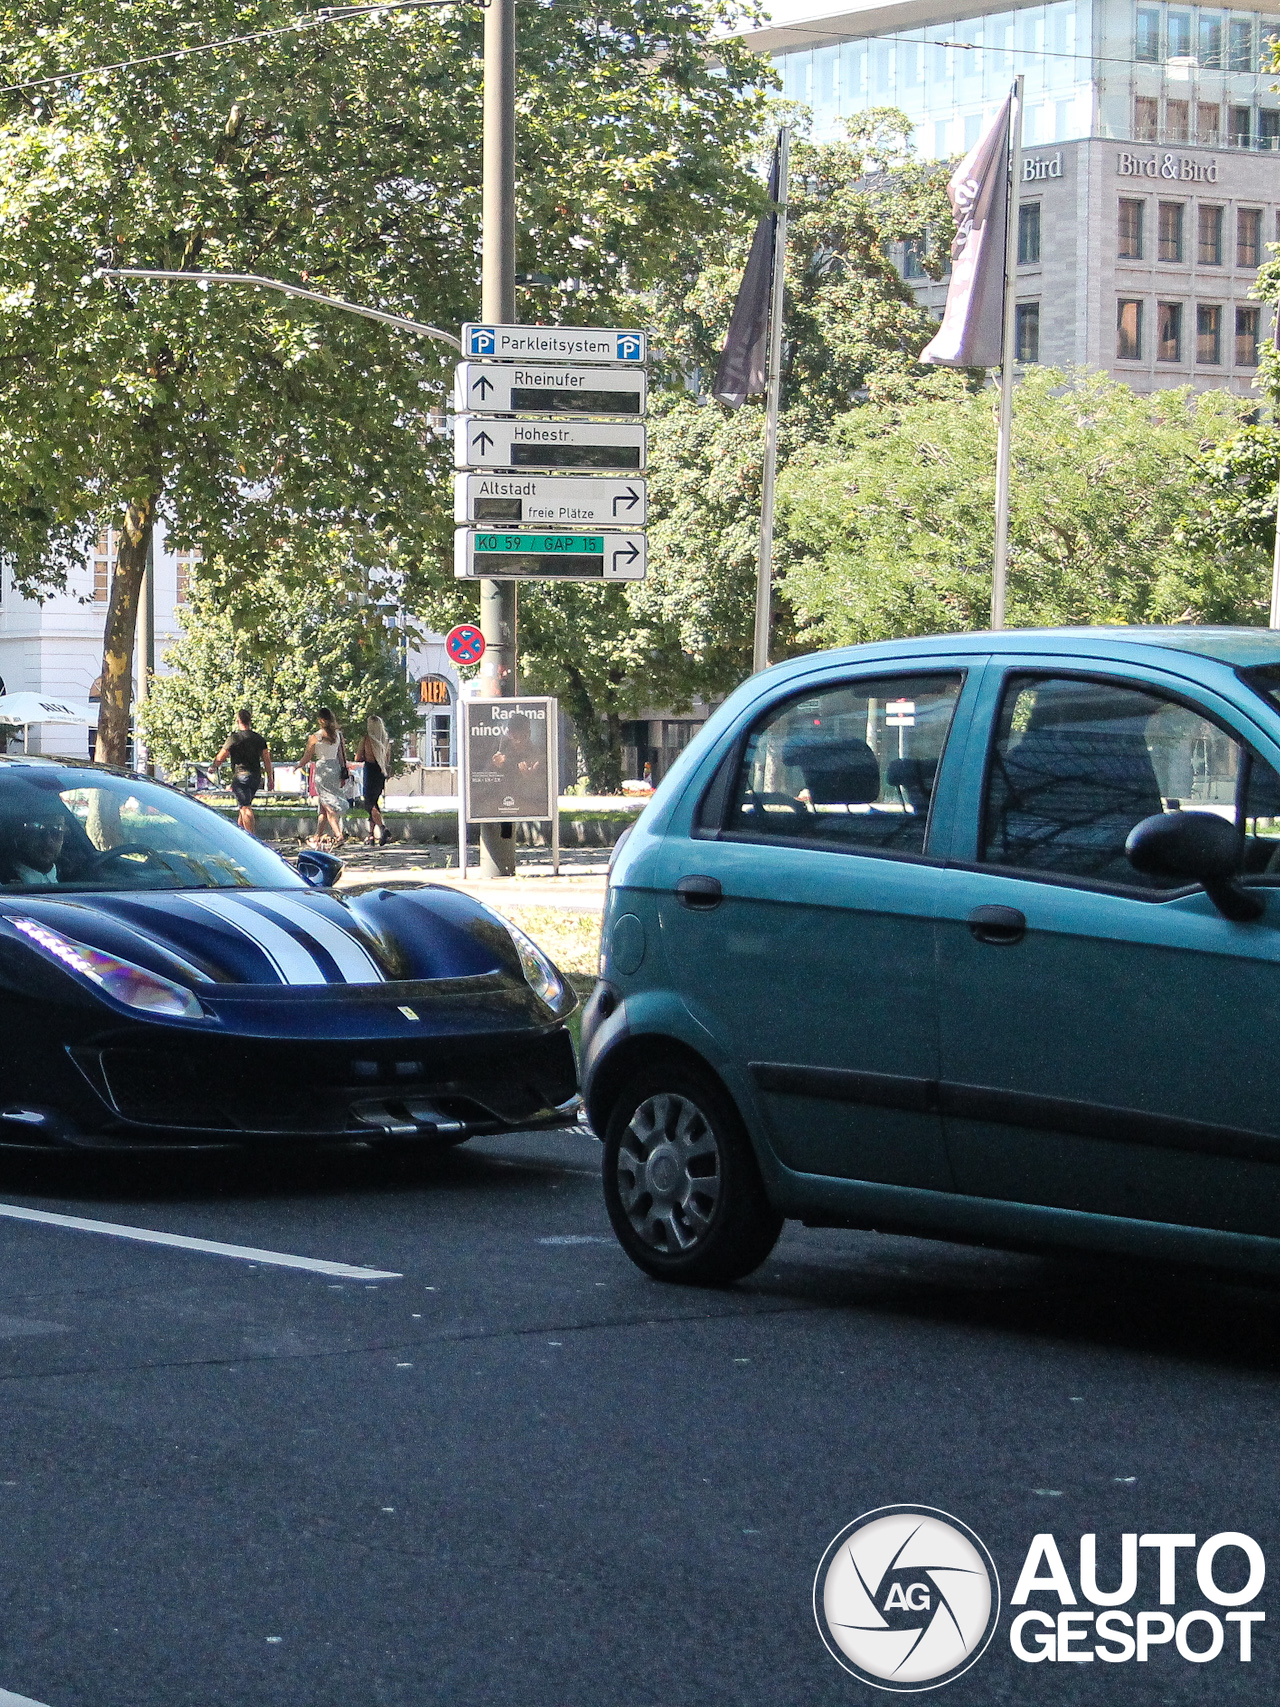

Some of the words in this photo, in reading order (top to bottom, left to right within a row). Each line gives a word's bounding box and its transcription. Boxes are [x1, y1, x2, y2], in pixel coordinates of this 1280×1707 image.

[1021, 152, 1062, 182] Bird
[501, 335, 610, 355] Parkleitsystem
[514, 371, 585, 387] Rheinufer
[514, 427, 574, 442] Hohestr.
[479, 482, 536, 496] Altstadt
[528, 507, 554, 519] freie
[558, 507, 594, 519] Plätze
[478, 534, 498, 550] KÖ
[505, 536, 521, 549] 59
[544, 537, 574, 550] GAP
[583, 538, 596, 551] 15
[420, 681, 448, 702] ALEX
